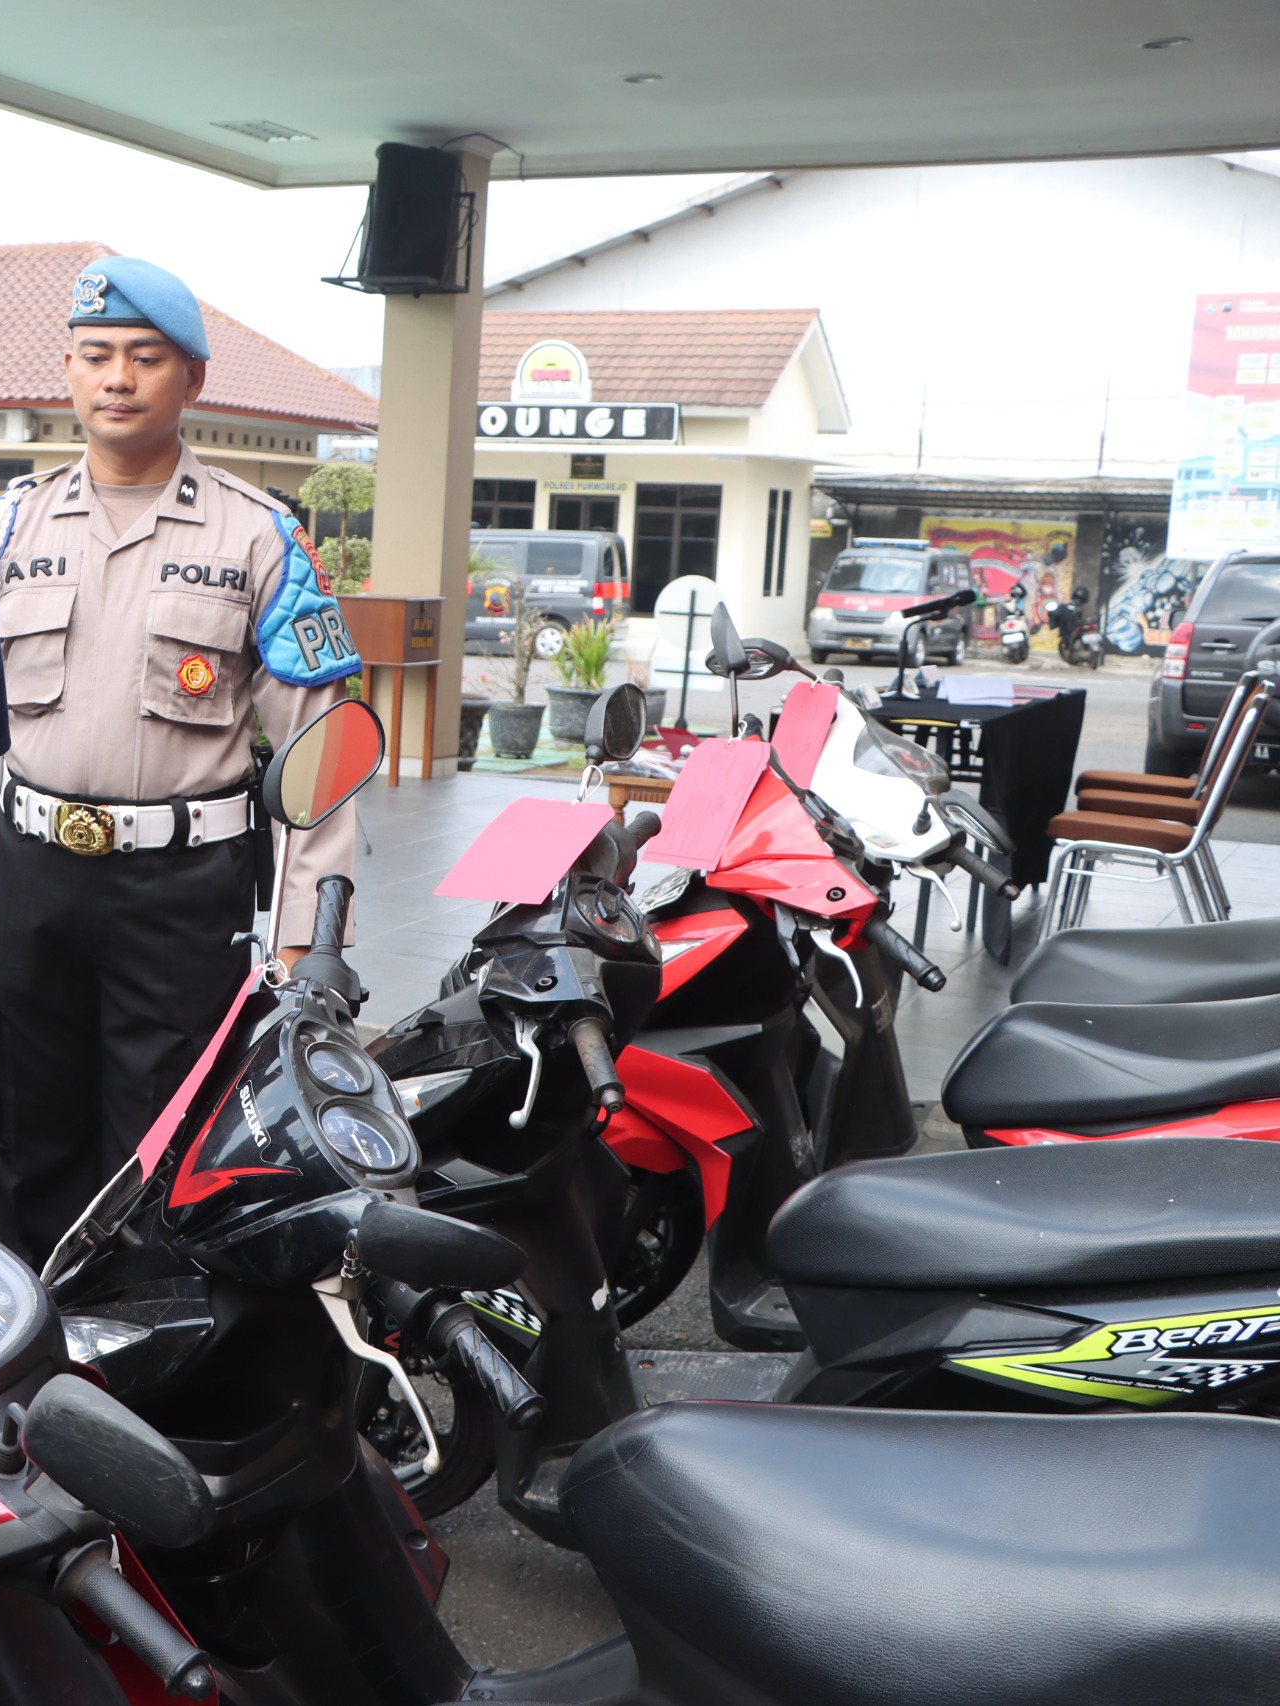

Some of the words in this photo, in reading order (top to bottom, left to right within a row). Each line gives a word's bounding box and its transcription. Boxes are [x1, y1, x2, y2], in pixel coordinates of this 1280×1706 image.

[480, 406, 646, 438] OUNGE
[4, 556, 66, 583] ARI
[160, 562, 247, 591] POLRI
[292, 607, 356, 671] PR
[240, 1085, 267, 1148] SUZUKI
[1087, 1375, 1134, 1386] Compact
[1135, 1381, 1194, 1394] Sportmatic
